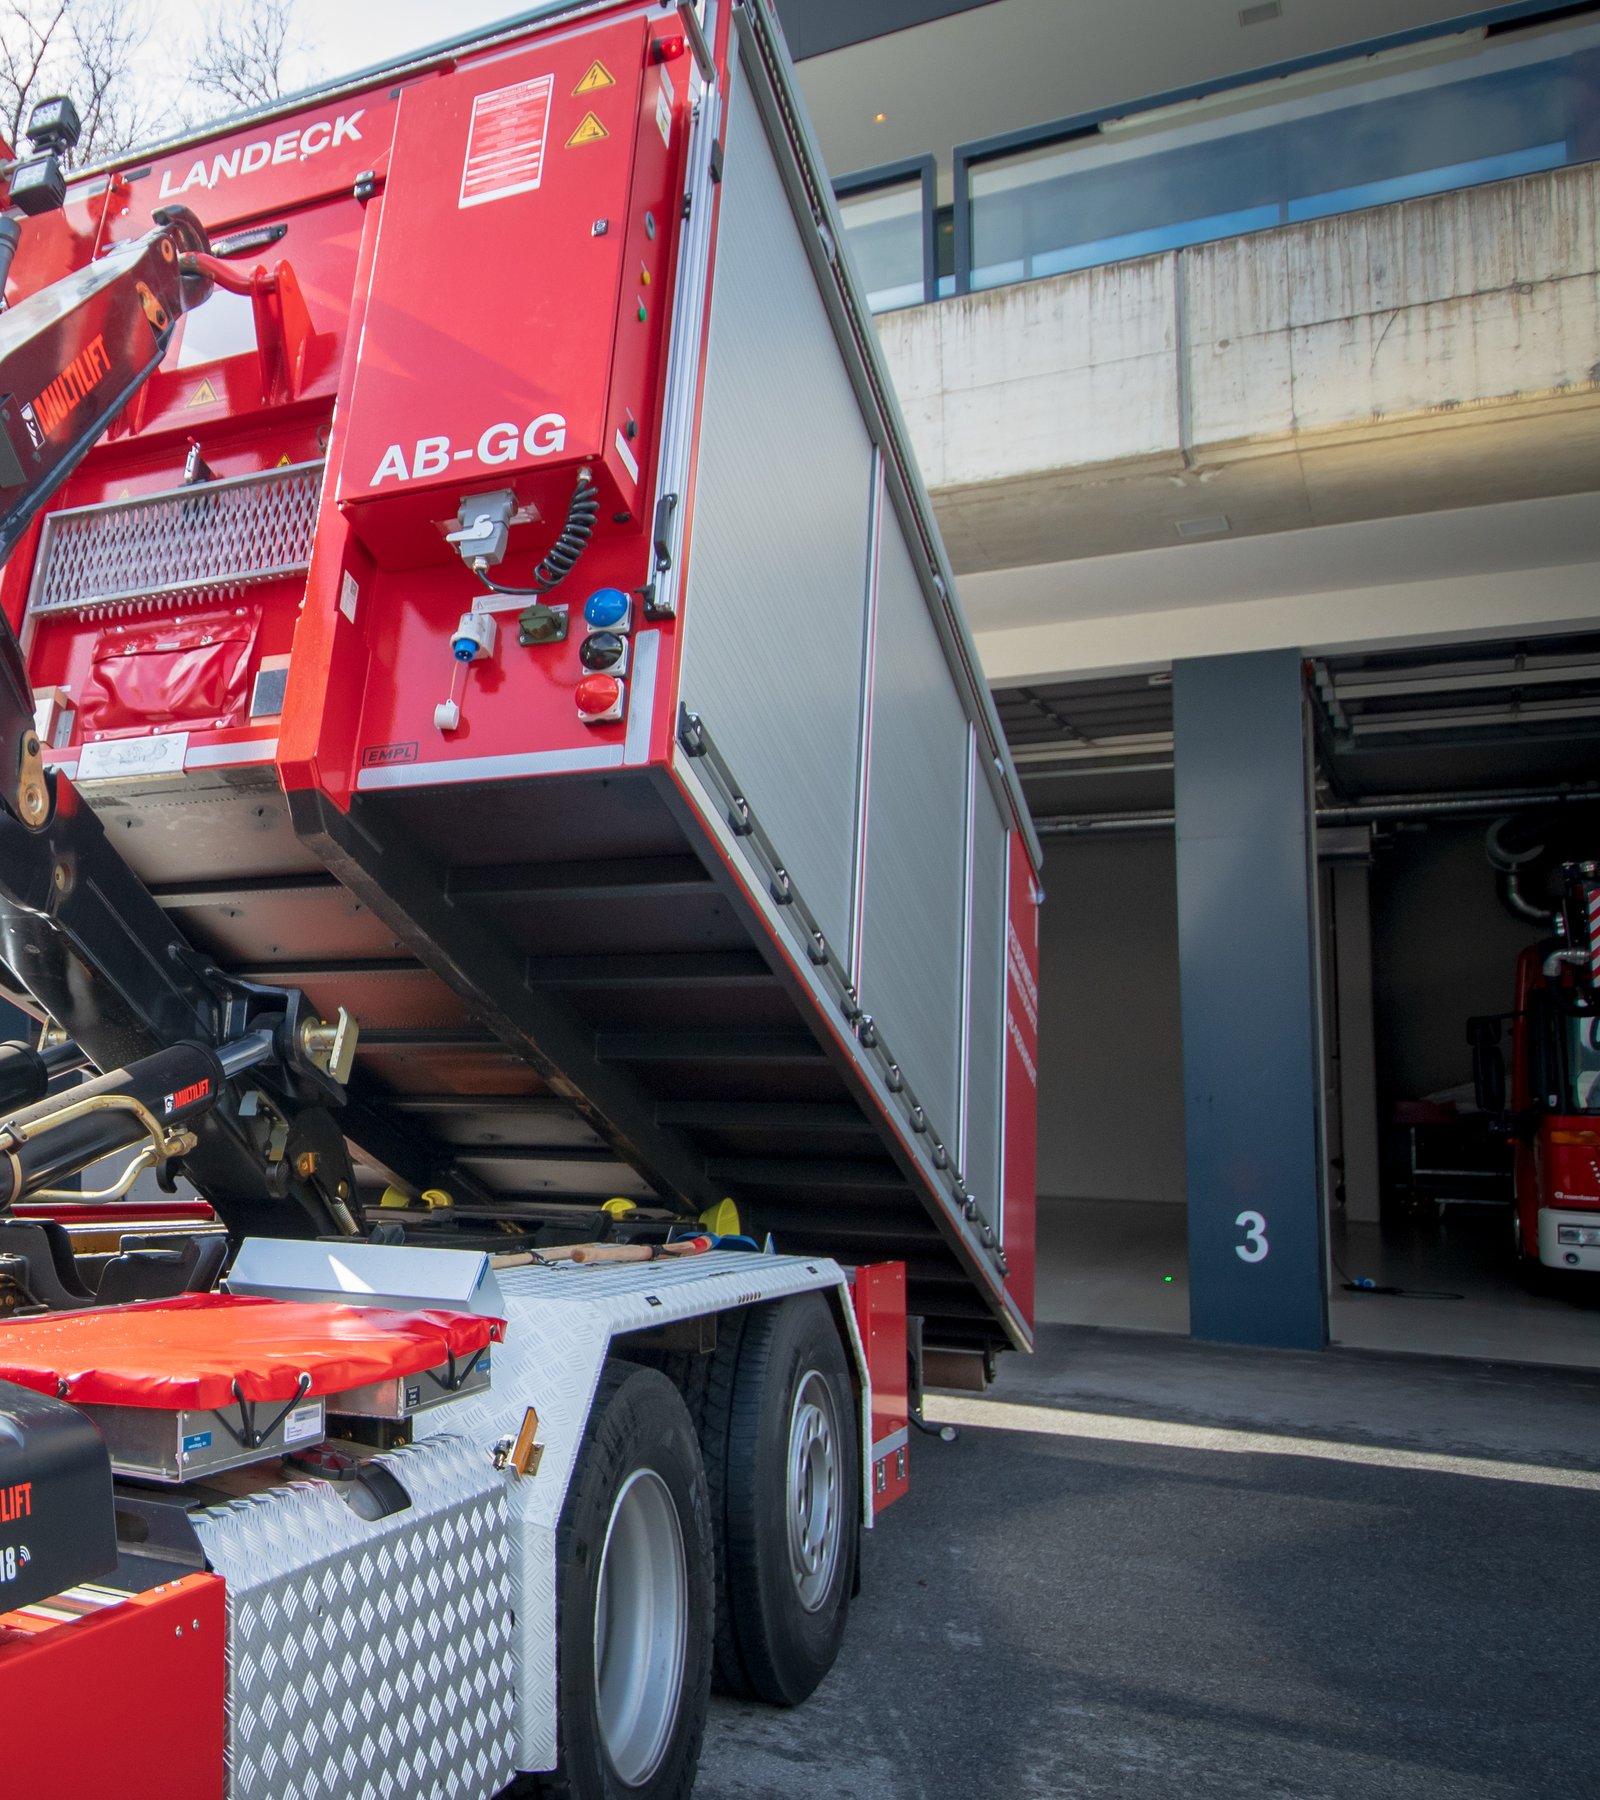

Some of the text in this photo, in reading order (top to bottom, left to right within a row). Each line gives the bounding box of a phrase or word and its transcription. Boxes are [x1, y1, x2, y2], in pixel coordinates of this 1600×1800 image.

[158, 109, 365, 199] LANDECK
[32, 333, 111, 436] MULTILIFT
[369, 413, 566, 487] AB-GG
[368, 747, 411, 761] EMPL
[174, 1078, 209, 1109] MULTILIFT
[1235, 1210, 1269, 1263] 3
